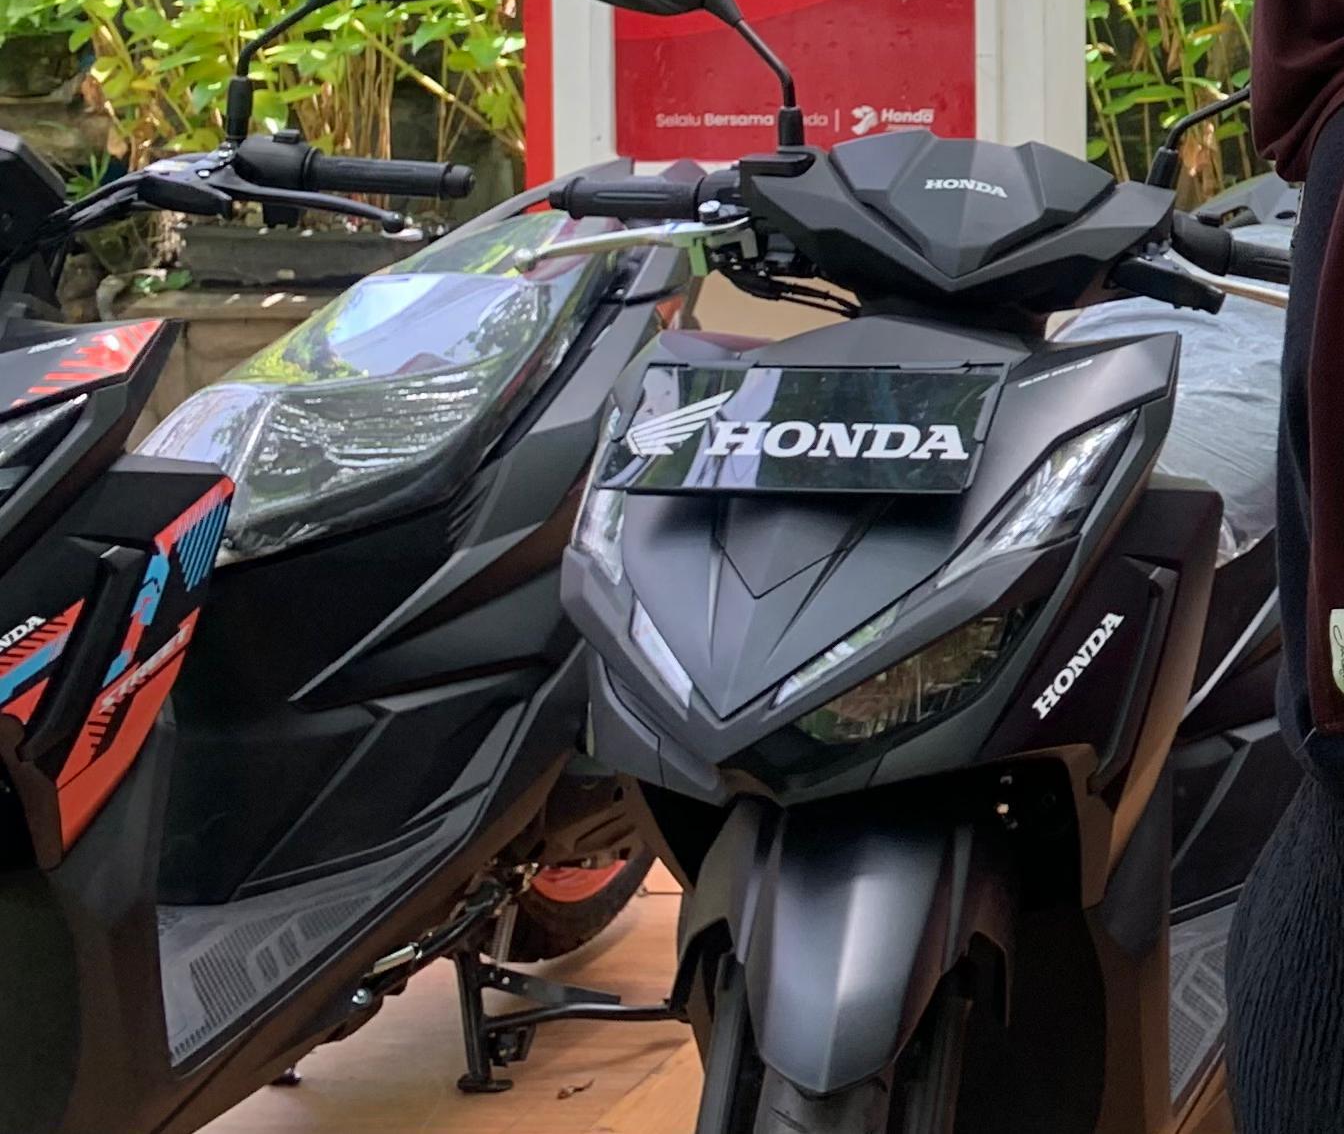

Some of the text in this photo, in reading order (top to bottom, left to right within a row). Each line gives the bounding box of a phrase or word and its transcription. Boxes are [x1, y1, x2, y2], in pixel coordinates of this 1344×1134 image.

[655, 113, 828, 128] Selalu Bersama nda
[881, 108, 934, 124] Honda
[924, 178, 1008, 199] HONDA
[704, 421, 969, 461] HONDA
[0, 615, 47, 654] NDA
[1032, 612, 1125, 720] HONDA
